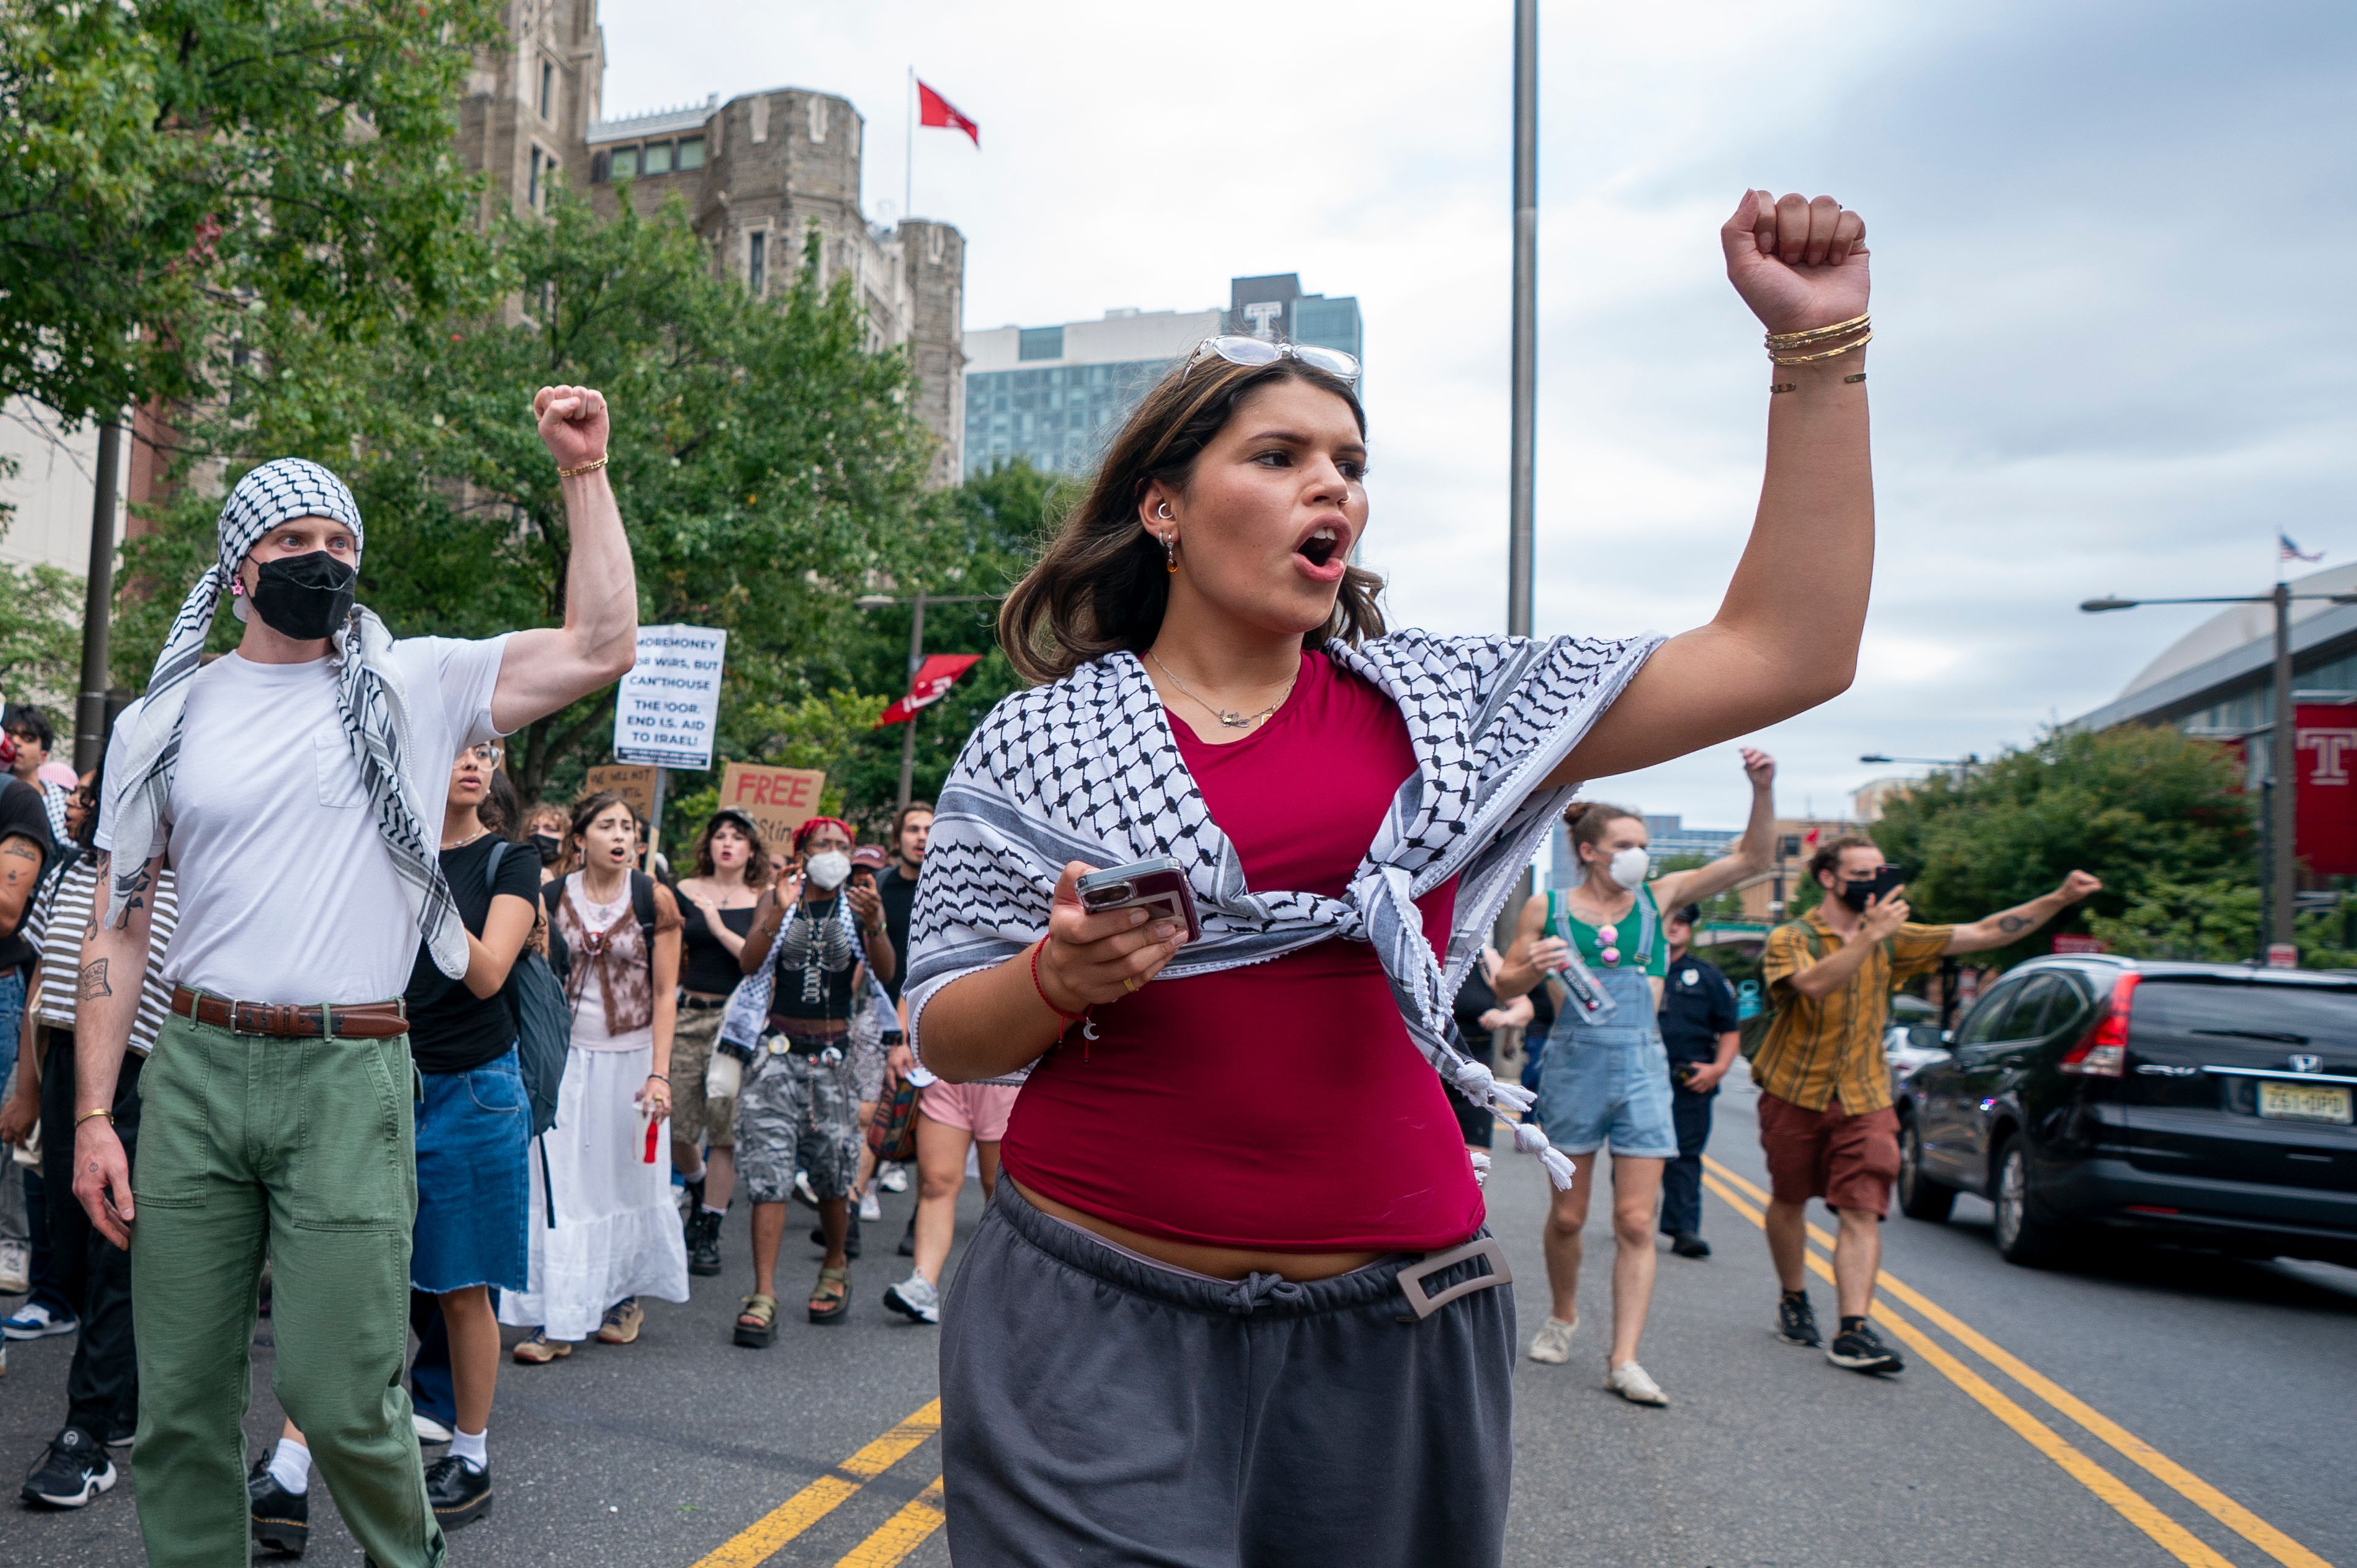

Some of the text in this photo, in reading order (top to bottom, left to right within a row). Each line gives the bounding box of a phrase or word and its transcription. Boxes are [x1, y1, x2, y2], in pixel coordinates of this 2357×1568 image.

[1244, 301, 1282, 341] T
[694, 660, 719, 671] BUT
[667, 678, 711, 691] HOUSE
[635, 699, 661, 711] THE
[627, 715, 656, 727] END
[682, 720, 705, 730] AID
[632, 731, 699, 747] TO ISRAEL!
[2296, 727, 2357, 786] T
[735, 773, 812, 808] FREE
[85, 964, 104, 979] NEWS
